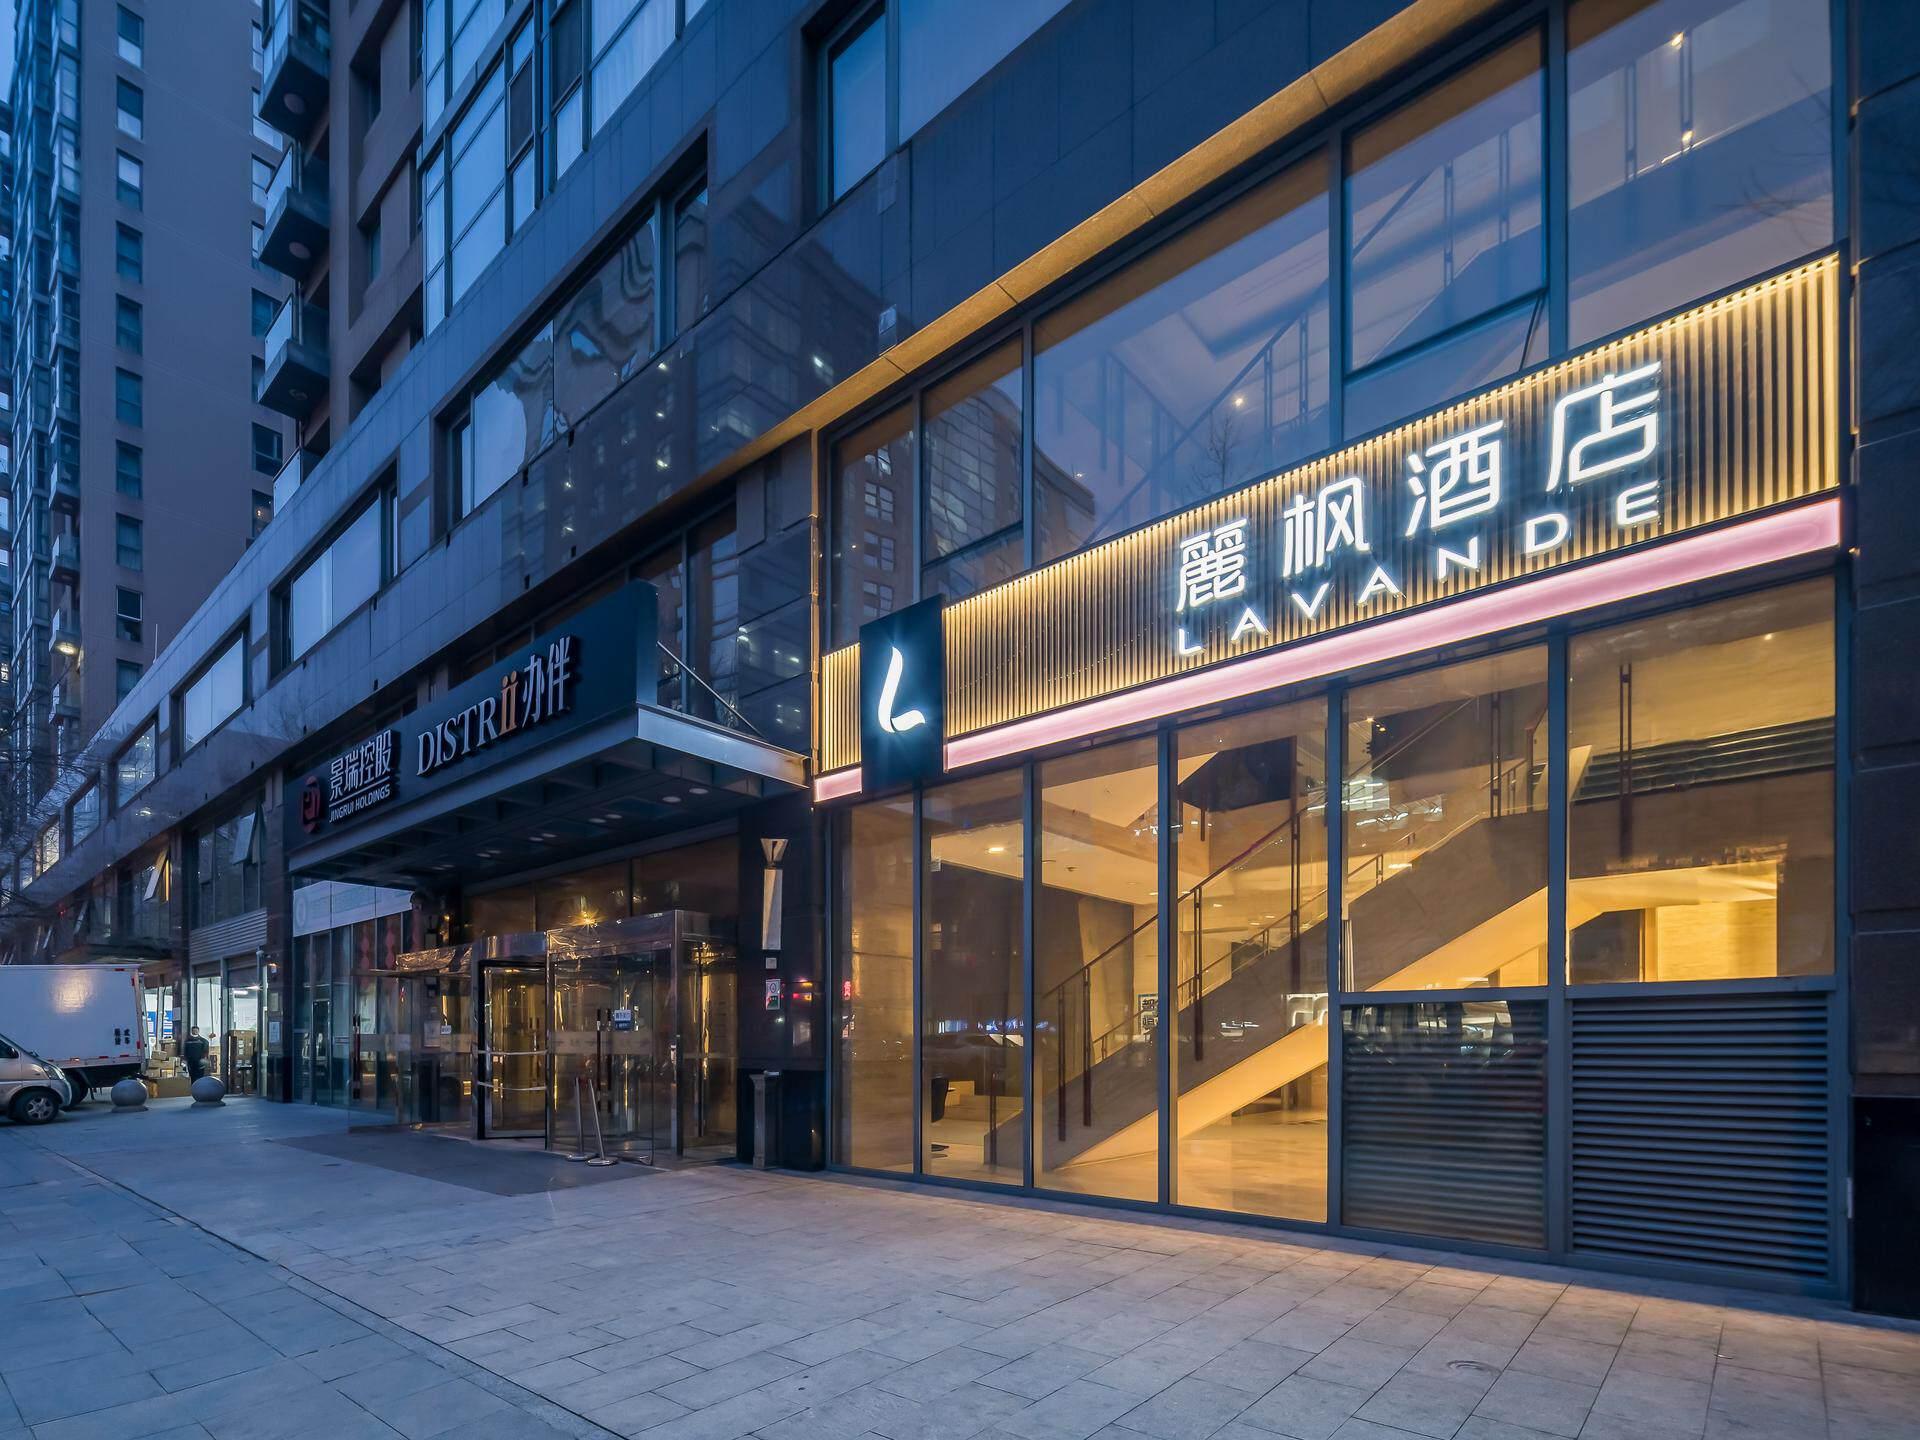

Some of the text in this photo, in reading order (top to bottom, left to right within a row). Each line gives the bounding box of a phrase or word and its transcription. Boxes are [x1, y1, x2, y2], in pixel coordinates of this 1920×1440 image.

[1177, 361, 1662, 612] 麗枫酒店
[1178, 479, 1660, 656] LAVANDE
[522, 636, 571, 728] 办伴
[329, 730, 392, 802] 景瑞控股
[329, 783, 391, 823] JINGRUI HOLDINGS
